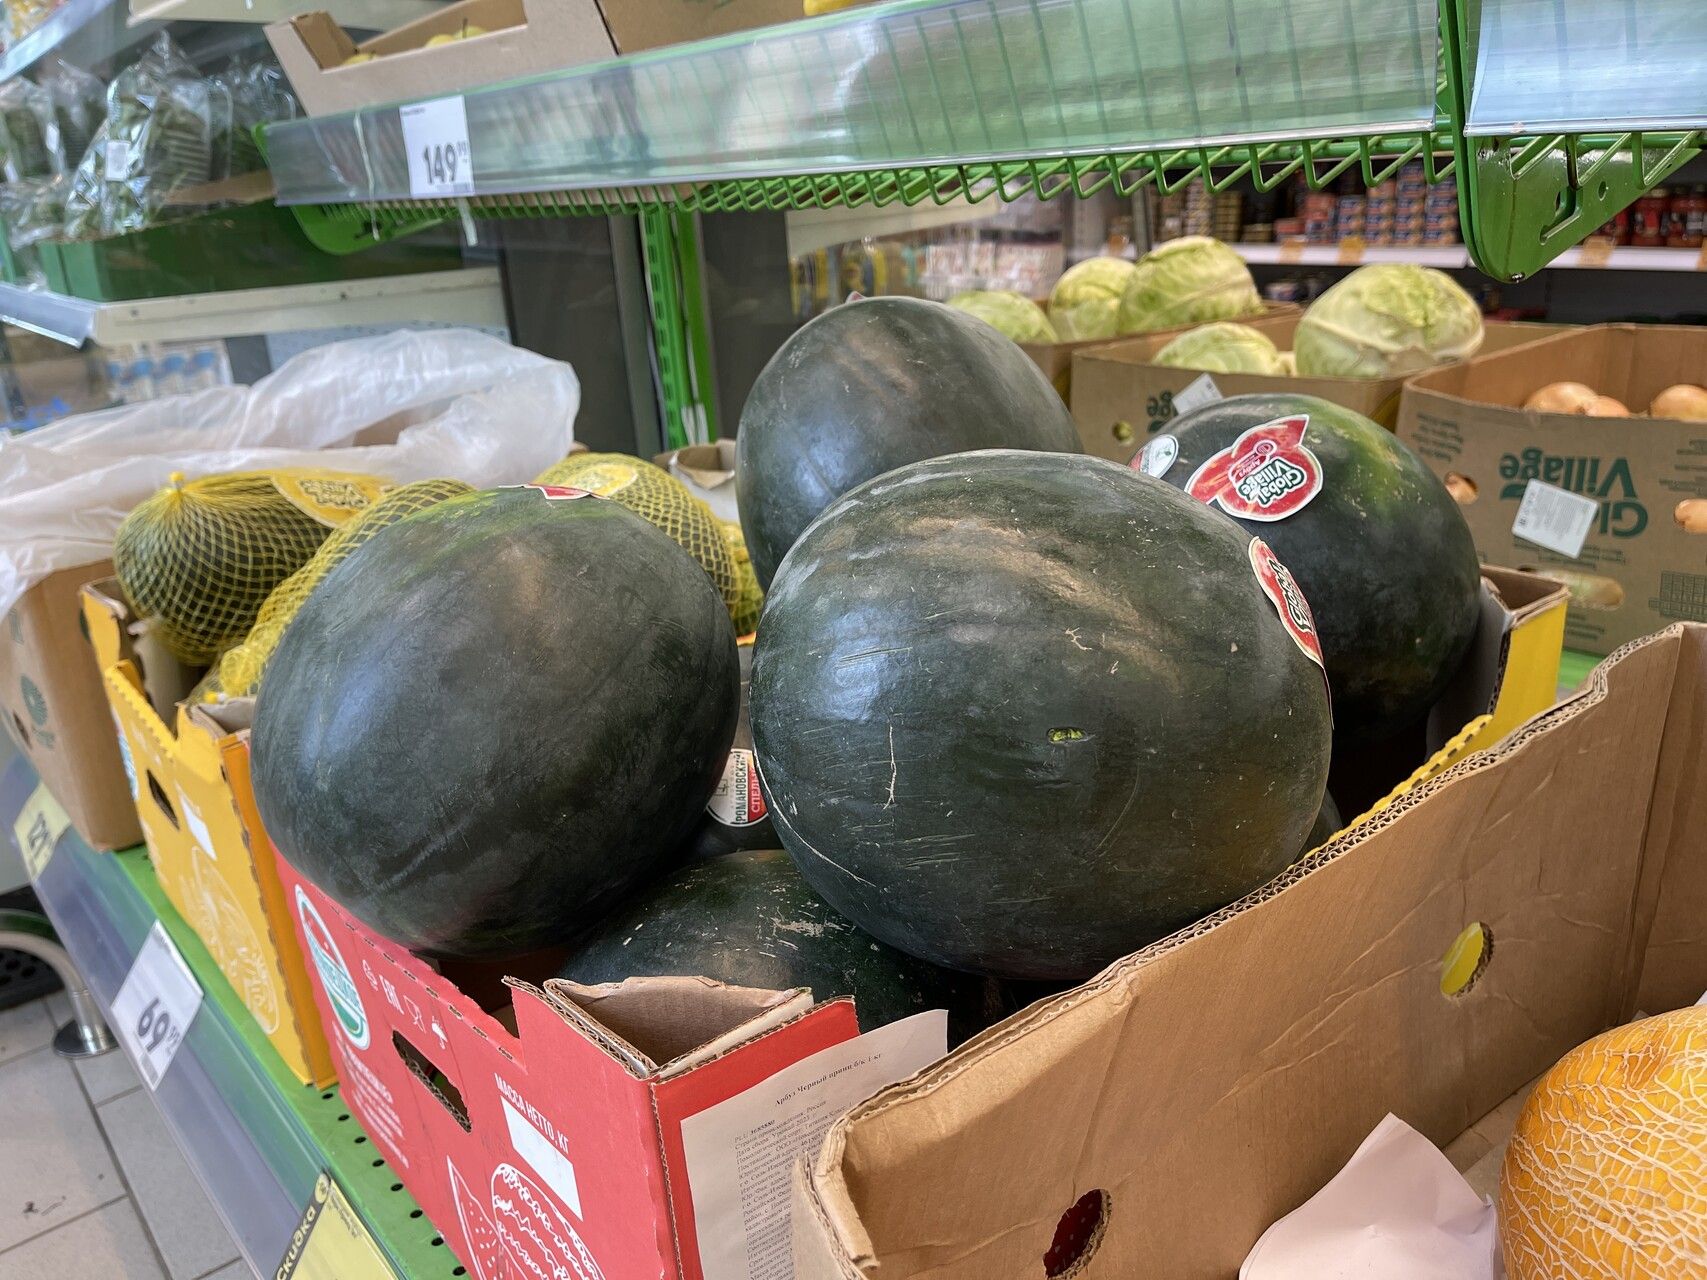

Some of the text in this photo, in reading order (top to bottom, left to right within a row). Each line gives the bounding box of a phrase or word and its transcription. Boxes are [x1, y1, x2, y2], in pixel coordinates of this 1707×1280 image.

[423, 143, 457, 184] 149
[1240, 460, 1291, 495] Village
[1259, 469, 1302, 503] Global
[1499, 446, 1639, 497] Village
[138, 998, 169, 1053] 69
[494, 1072, 527, 1115] МАССА
[557, 1130, 569, 1154] КГ
[276, 1204, 317, 1280] Скидка
